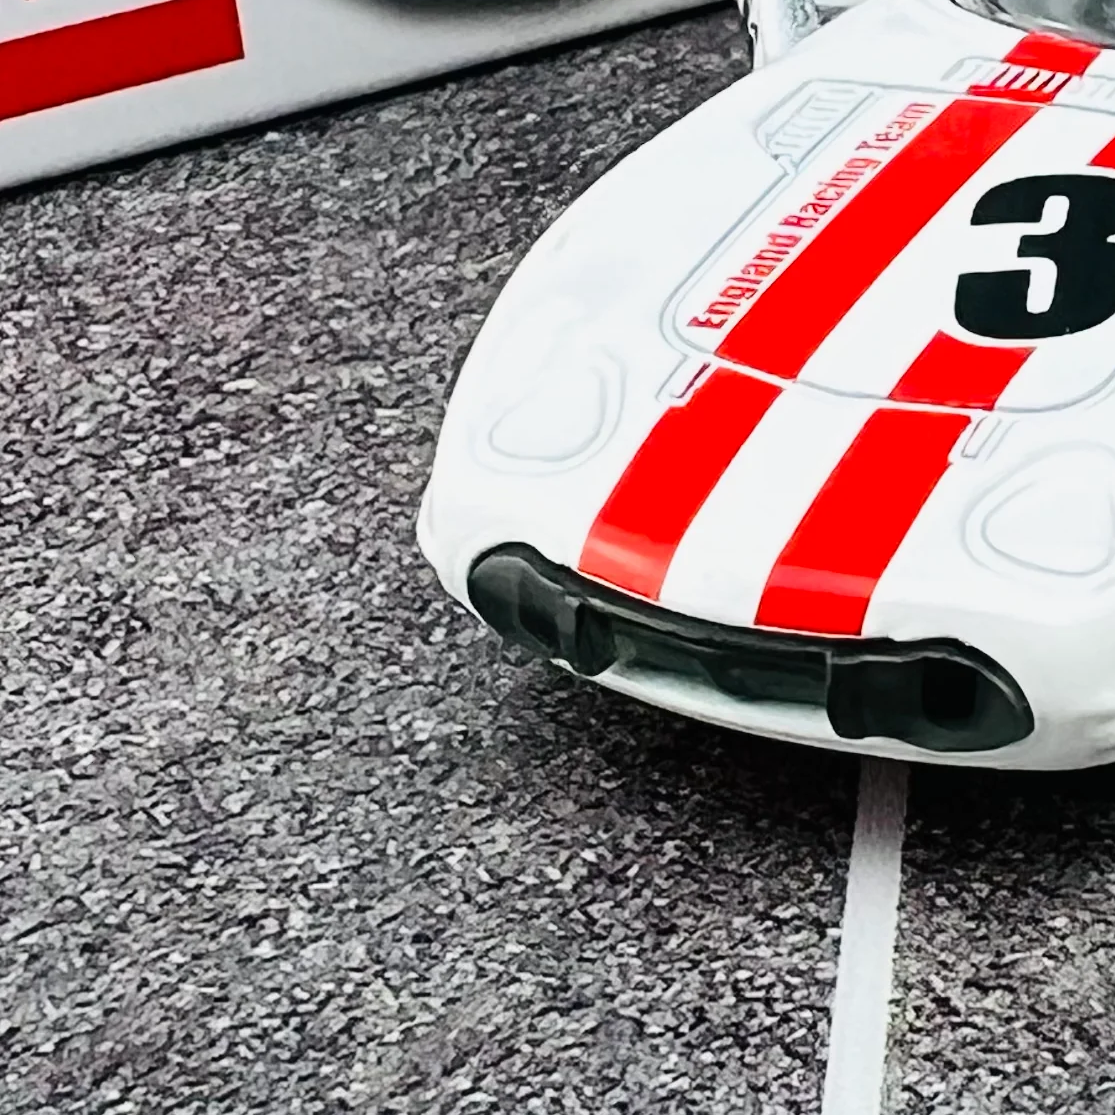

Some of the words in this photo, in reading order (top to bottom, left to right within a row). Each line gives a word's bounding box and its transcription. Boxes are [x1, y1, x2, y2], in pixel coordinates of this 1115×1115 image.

[686, 231, 802, 330] England
[778, 157, 883, 229] Racing
[854, 101, 937, 152] Team
